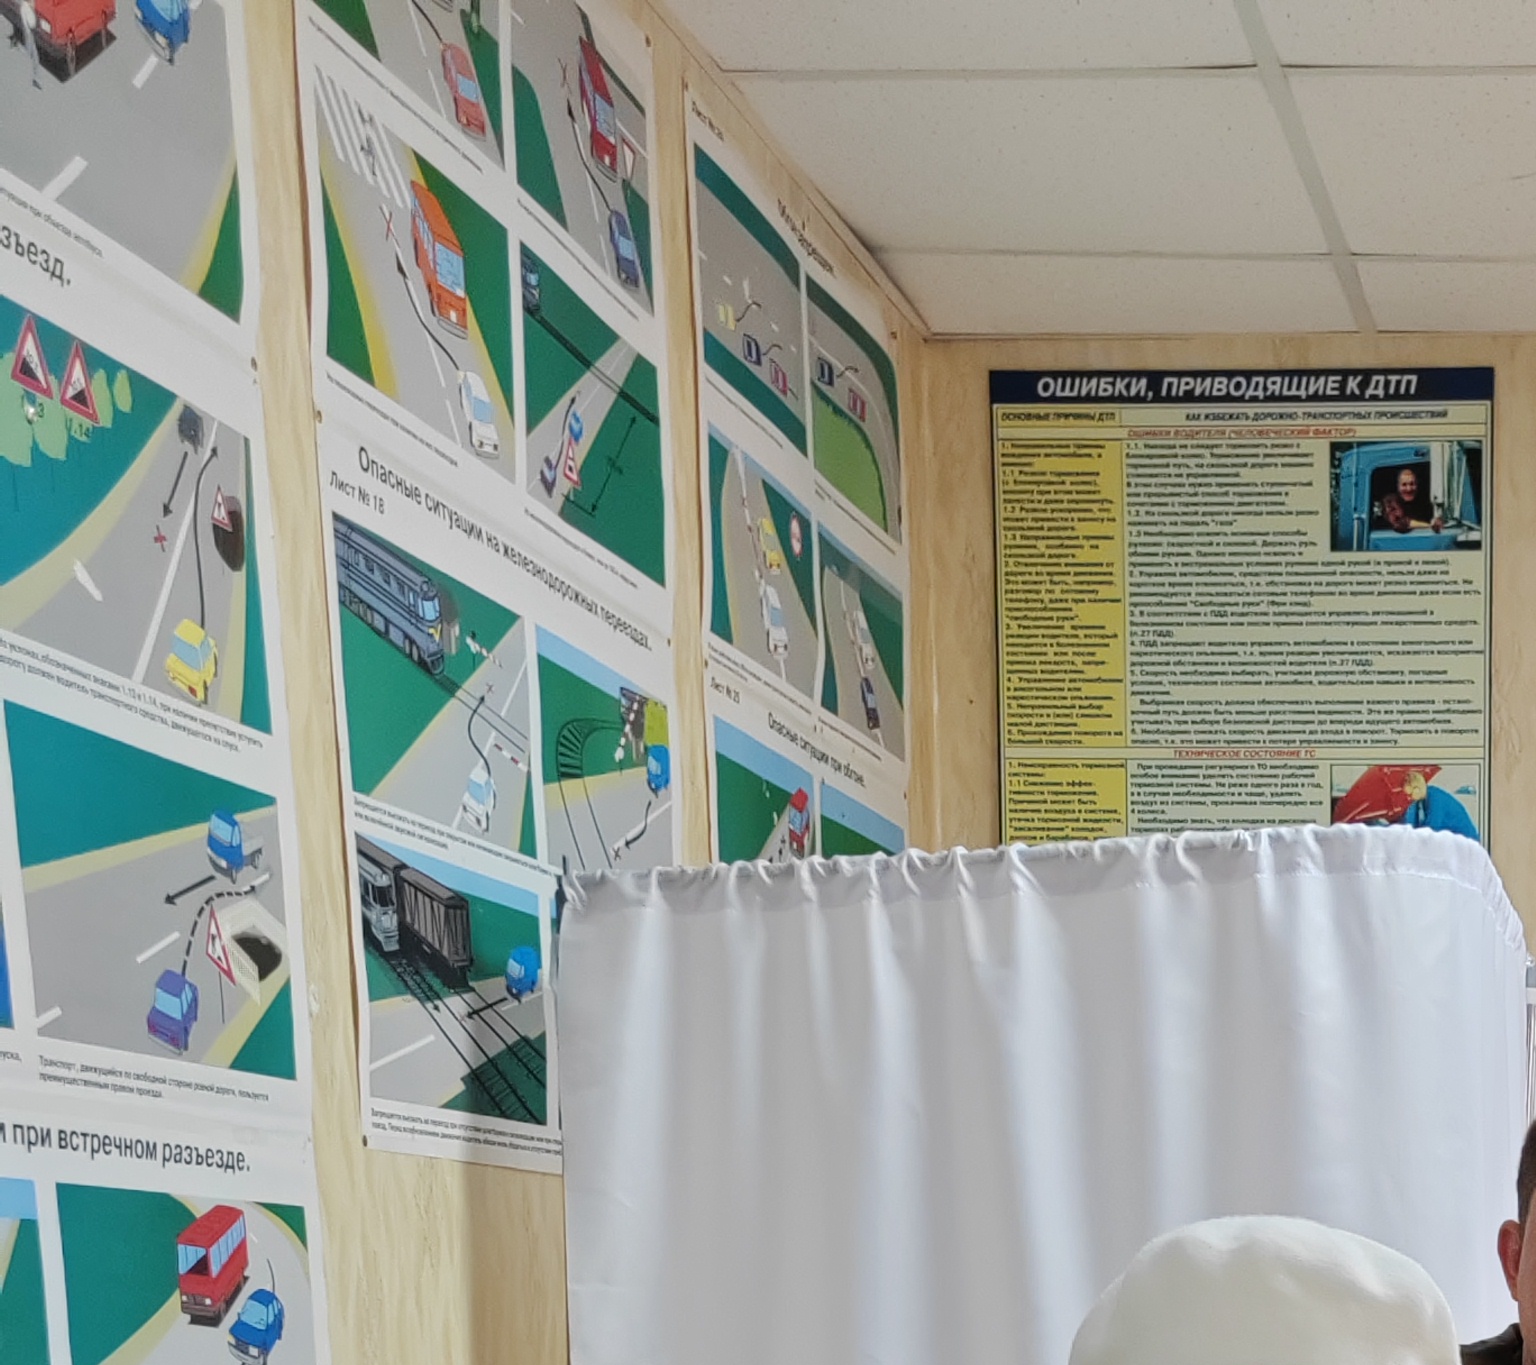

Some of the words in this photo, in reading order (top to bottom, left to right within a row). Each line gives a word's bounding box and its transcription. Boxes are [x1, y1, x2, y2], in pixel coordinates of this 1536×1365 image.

[0, 226, 71, 287] зъезд.
[1037, 377, 1154, 400] ОШИБКИ,
[1161, 375, 1341, 398] ПРИВОДЯЩИЕ
[1345, 375, 1364, 396] К
[1366, 374, 1418, 397] ДТП
[1001, 412, 1051, 422] ОСНОВНЫЕ
[1097, 412, 1116, 422] ДТП
[1185, 412, 1202, 421] КАК
[1252, 411, 1372, 422] ДОРОЖНО-ТРАНСПОРТНЫХ
[330, 471, 356, 500] Лист
[358, 486, 371, 506] №
[373, 493, 385, 515] 18
[358, 446, 421, 505] Опасные
[424, 492, 484, 543] ситуации
[485, 529, 500, 555] на
[501, 544, 599, 617] железнодорожных
[1173, 749, 1241, 758] ТЕХНИЧЕСКОЕ
[1243, 749, 1302, 758] СОСТОЯНИЕ
[1304, 749, 1316, 758] ТС
[12, 1122, 52, 1153] при
[58, 1130, 157, 1162] встречном
[162, 1141, 251, 1175] разъезде.
